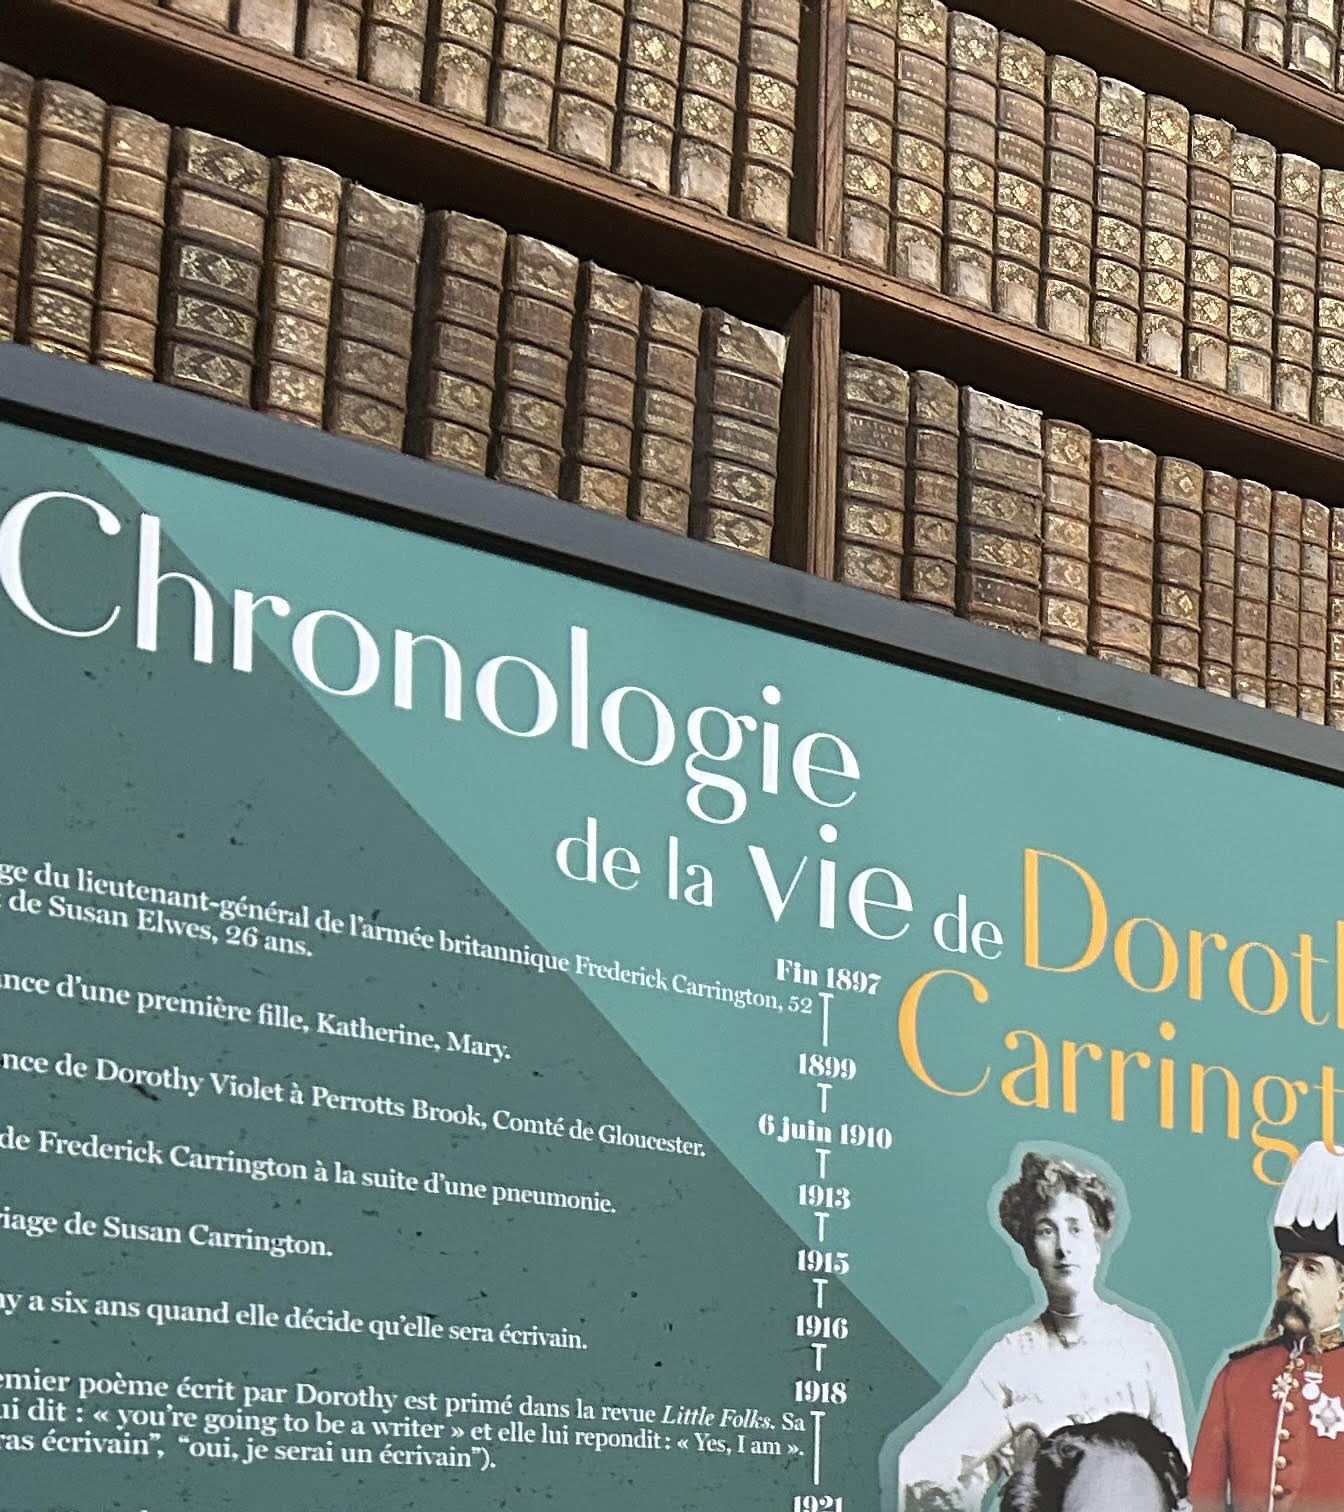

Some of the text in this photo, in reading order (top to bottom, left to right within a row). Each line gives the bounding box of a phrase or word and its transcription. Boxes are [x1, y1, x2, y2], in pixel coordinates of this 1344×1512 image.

[0, 490, 862, 825] Chronologie
[556, 816, 642, 891] de
[668, 835, 714, 907] la
[932, 893, 1005, 961] de
[33, 862, 71, 890] du
[76, 867, 311, 929] lieutenant-général
[314, 909, 345, 934] de
[438, 929, 570, 974] britannique
[575, 954, 668, 991] Frederick
[671, 974, 784, 1012] Carrington,
[787, 995, 813, 1015] 52
[776, 958, 882, 995] Fin 1897
[799, 1053, 857, 1080] 1899
[54, 1052, 706, 1158] de Dorothy Violet à Perrotts Brook, Comté de Gloucester.
[758, 1113, 893, 1150] 6 juin 1910
[799, 1184, 851, 1210] 1913
[63, 1211, 333, 1258] de Susan Carrington.
[798, 1249, 850, 1275] 1915
[796, 1315, 849, 1339] 1916
[795, 1380, 848, 1404] 1918
